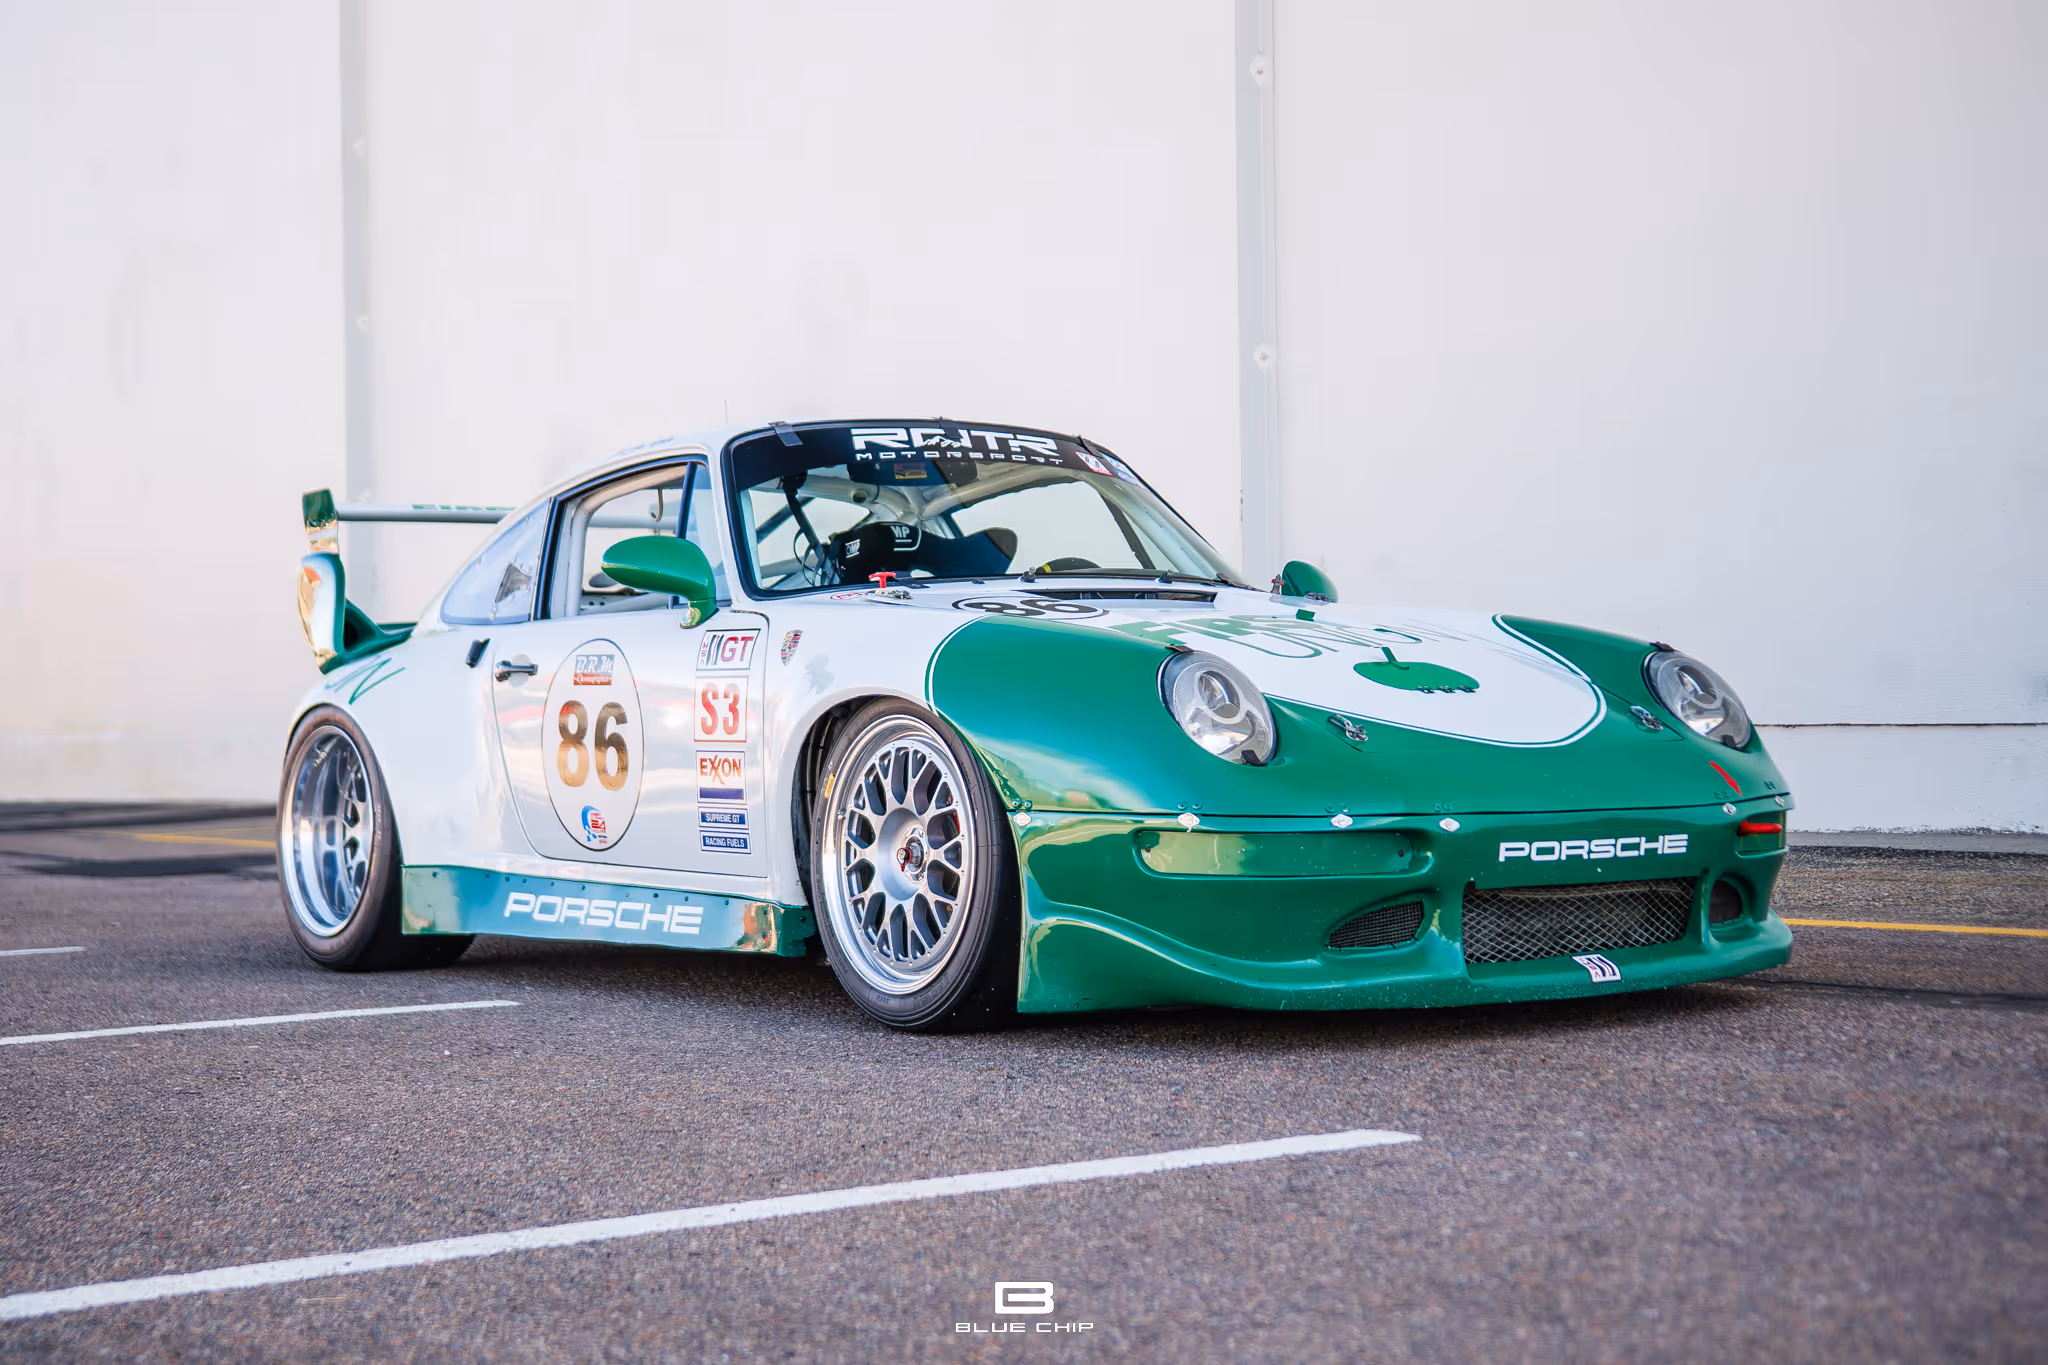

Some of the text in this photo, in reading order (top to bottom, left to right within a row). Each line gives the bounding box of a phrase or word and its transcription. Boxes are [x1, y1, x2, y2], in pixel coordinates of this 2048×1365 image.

[855, 451, 1064, 466] MOTORSPORT
[964, 599, 1098, 616] 86
[720, 636, 754, 662] GT
[700, 683, 740, 736] S3
[557, 700, 629, 791] 86
[700, 755, 741, 785] EXXON
[705, 812, 741, 823] SUPREME GT
[705, 837, 745, 848] RACING FUELS
[1498, 834, 1688, 862] PORSCHE
[504, 892, 704, 935] PORSCHE
